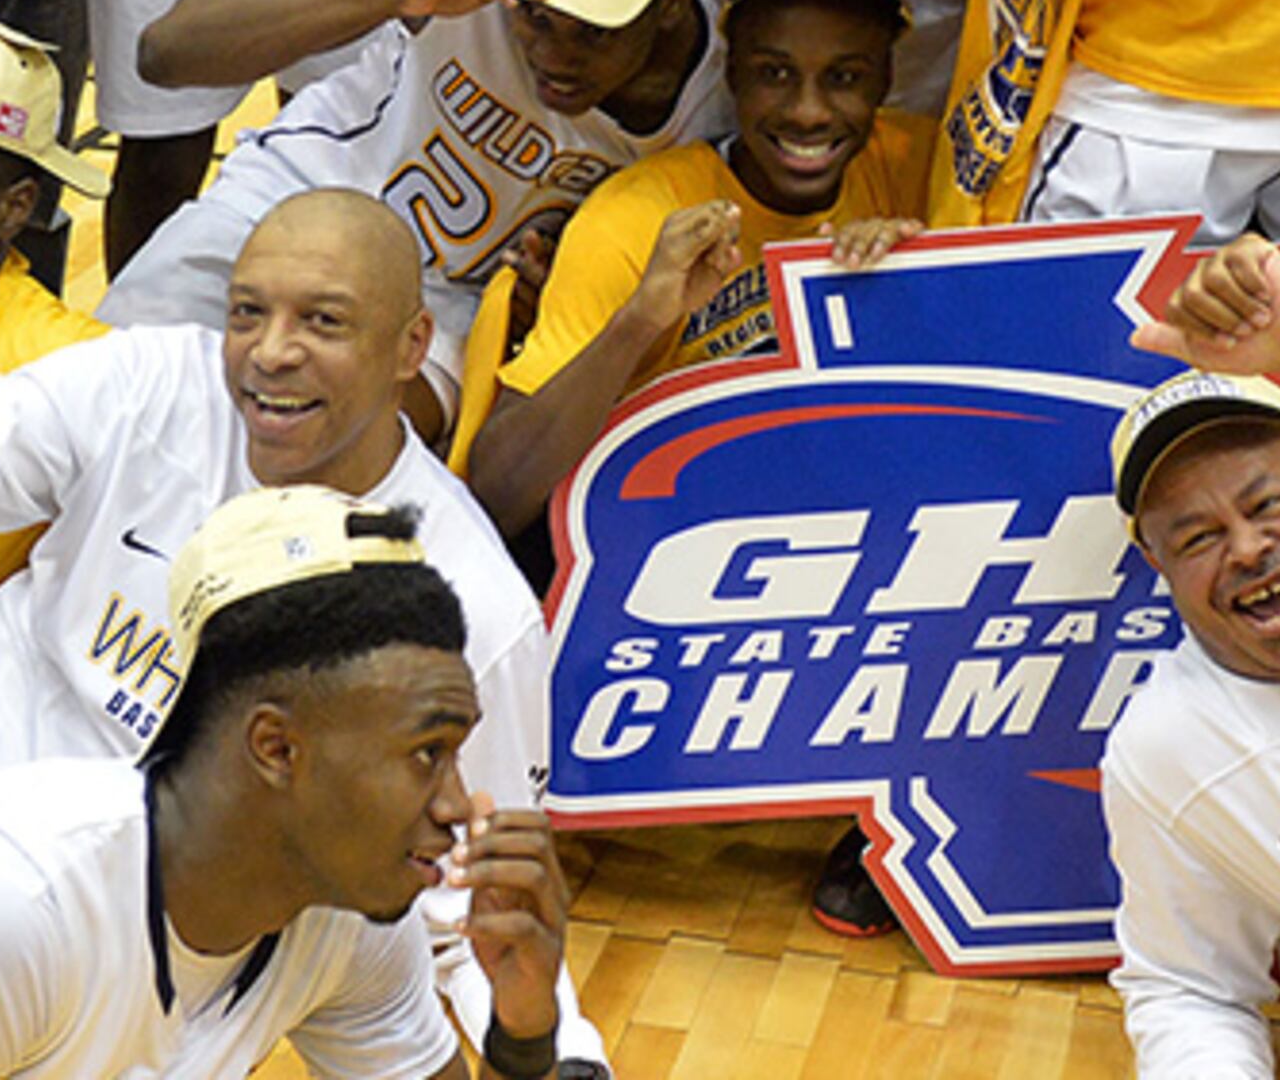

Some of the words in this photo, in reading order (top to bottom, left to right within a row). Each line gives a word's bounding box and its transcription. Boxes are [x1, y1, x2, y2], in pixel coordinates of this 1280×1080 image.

[706, 312, 771, 358] REGIO
[624, 494, 1165, 628] GH
[606, 622, 912, 672] STATE
[570, 651, 1160, 761] CHAMP
